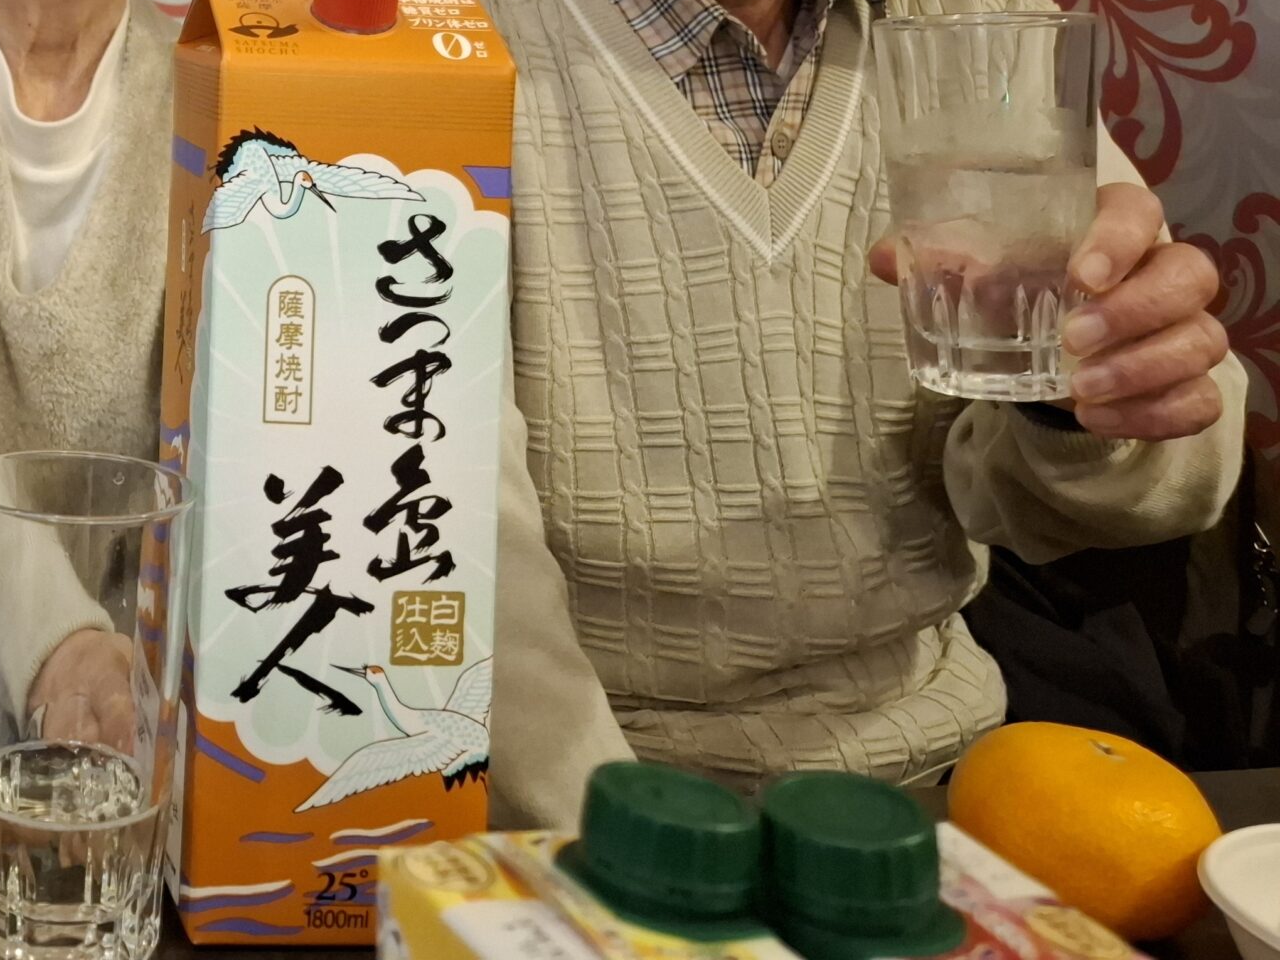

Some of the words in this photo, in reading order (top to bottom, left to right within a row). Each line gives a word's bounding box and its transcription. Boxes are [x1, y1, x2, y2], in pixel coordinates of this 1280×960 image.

[408, 17, 489, 29] プリン体ゼロ
[273, 290, 306, 415] 薩摩焼酎
[305, 908, 369, 930] 1800ml
